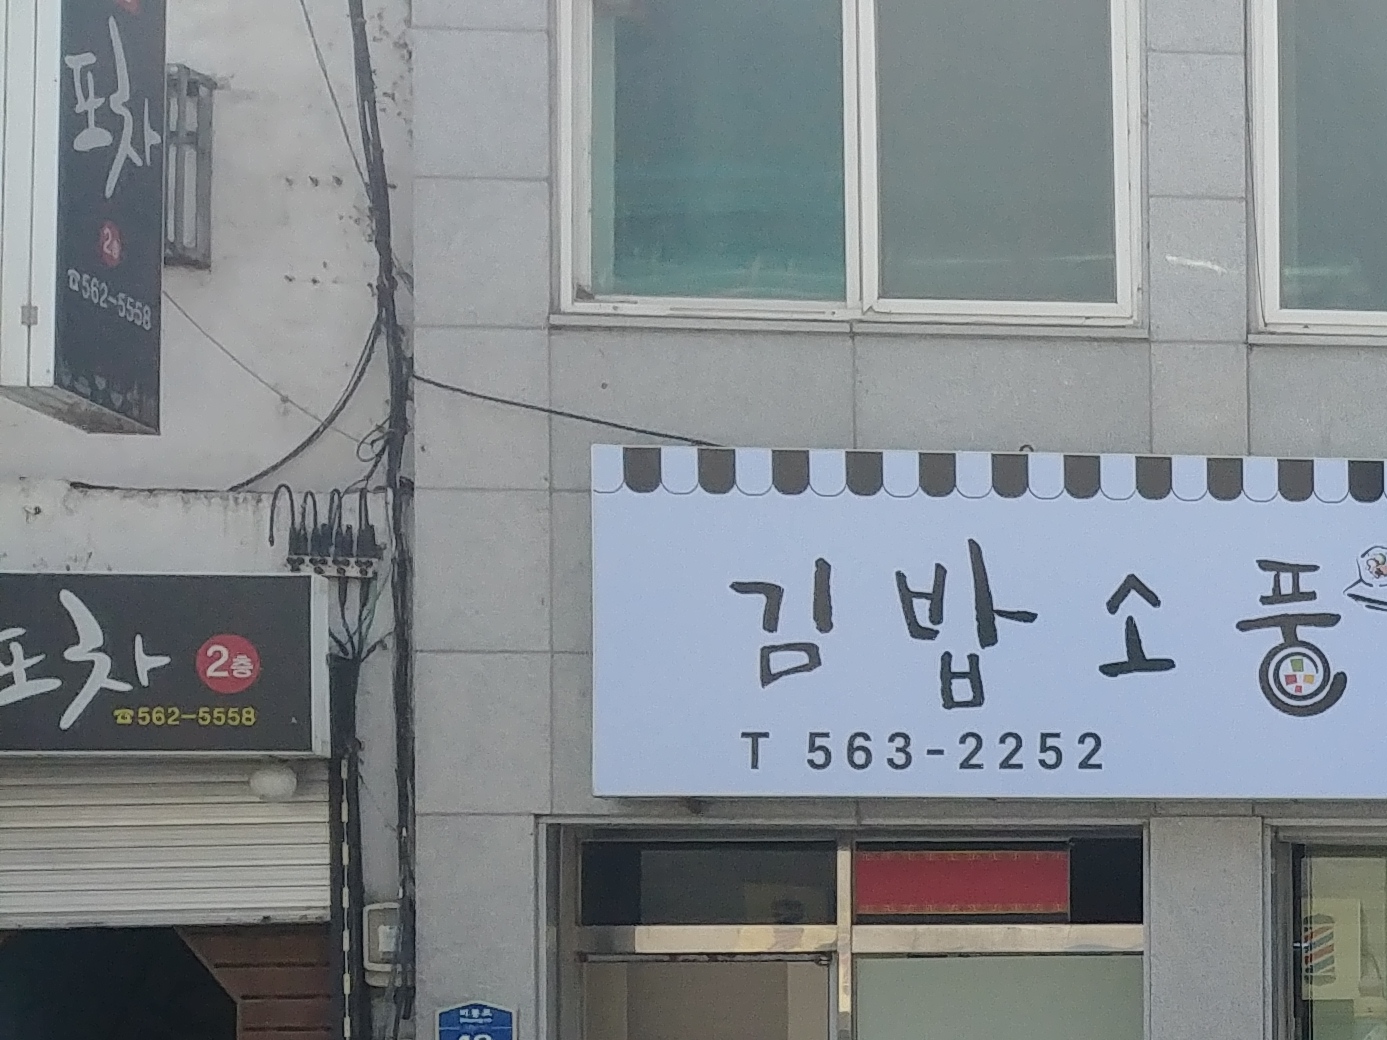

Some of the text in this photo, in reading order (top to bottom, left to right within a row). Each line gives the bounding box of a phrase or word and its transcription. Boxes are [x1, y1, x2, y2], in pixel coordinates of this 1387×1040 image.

[82, 274, 152, 331] 562-5558
[205, 644, 254, 679] 2층
[138, 706, 256, 726] 562-5558
[741, 730, 1105, 770] T 563-2252
